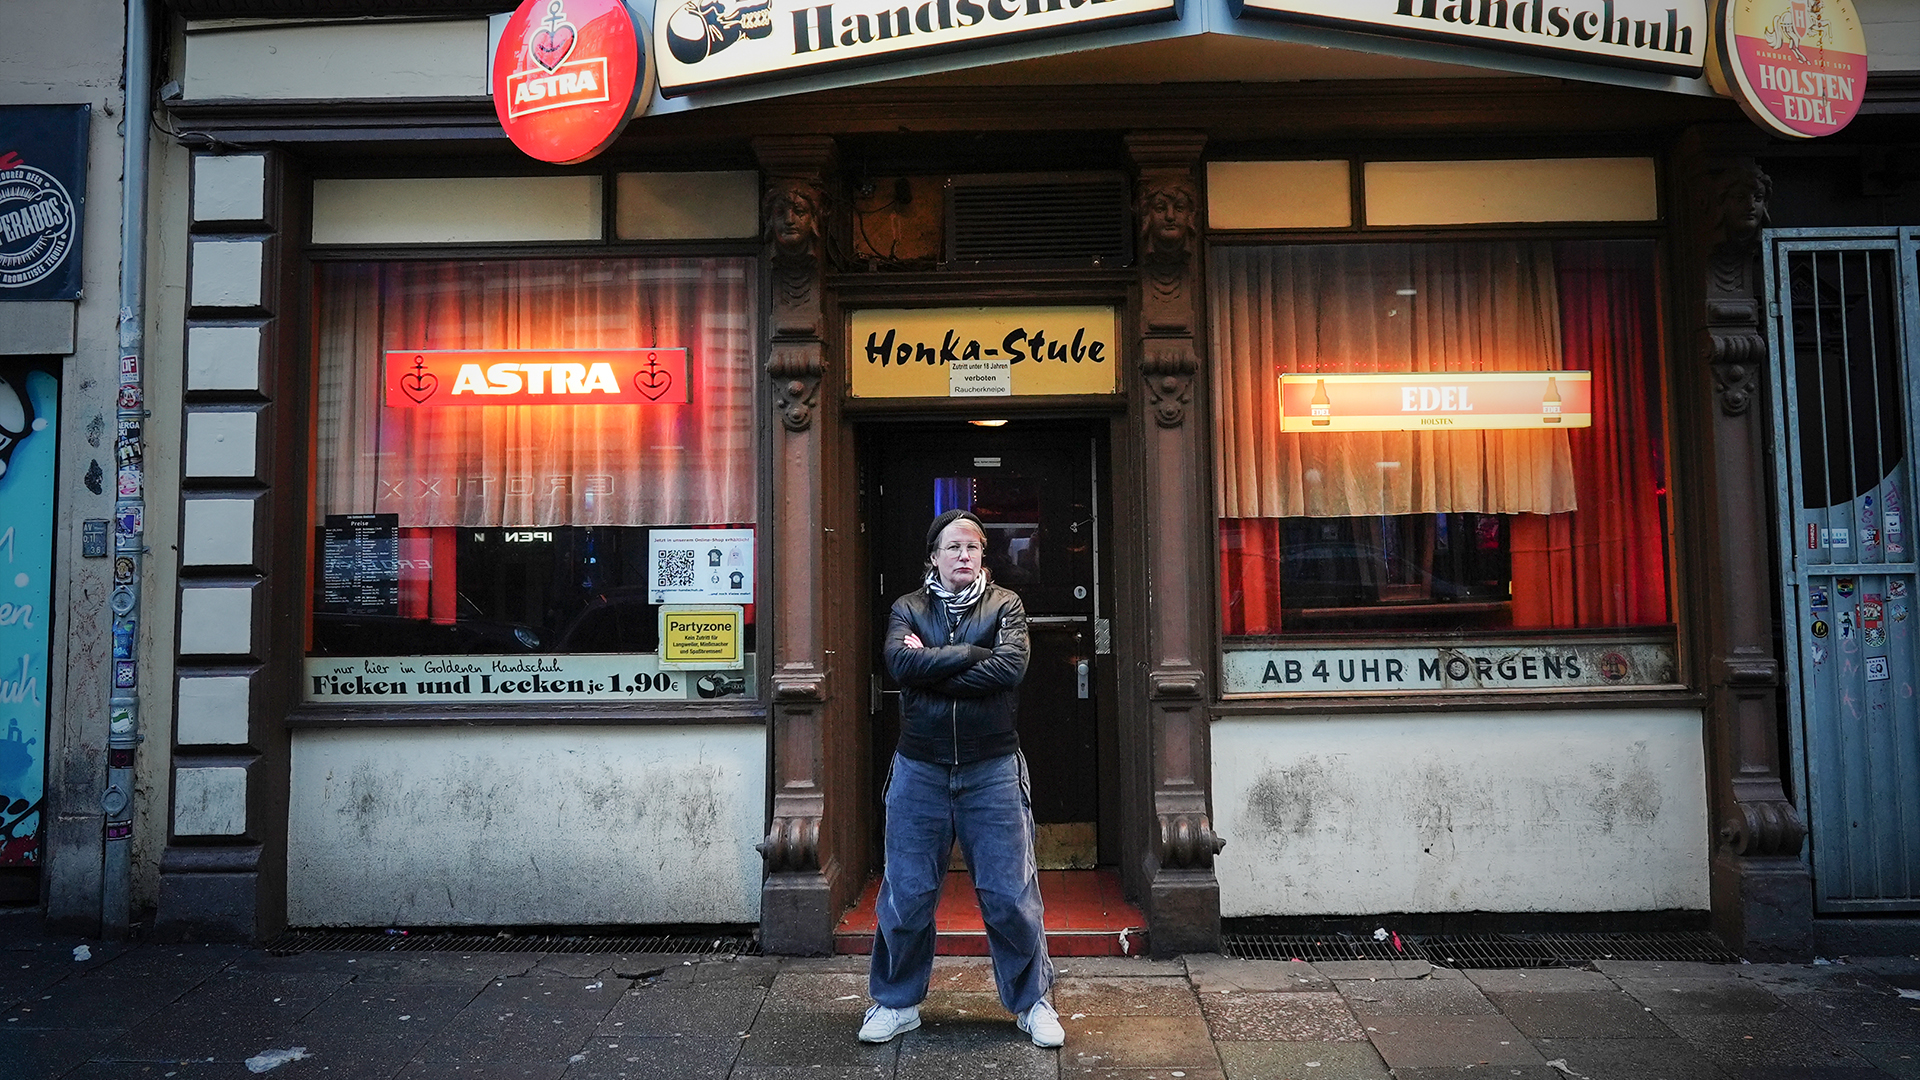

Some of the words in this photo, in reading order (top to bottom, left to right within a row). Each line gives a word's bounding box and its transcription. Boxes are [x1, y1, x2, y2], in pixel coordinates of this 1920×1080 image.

[790, 0, 1112, 55] Handsc
[514, 70, 598, 105] ASTRA
[1759, 64, 1853, 101] HOLSTEN
[1782, 94, 1837, 125] EDEL
[26, 171, 43, 187] BEER
[44, 241, 66, 268] TEQUILA
[865, 327, 1105, 367] Honka-Stube
[451, 362, 621, 395] ASTRA
[954, 386, 1005, 394] Raucherkneipe
[1311, 408, 1330, 416] EDEL
[1401, 386, 1473, 412] EDEL
[1543, 405, 1562, 414] EDEL
[670, 621, 732, 632] Partyzone
[334, 665, 354, 674] nur
[364, 659, 389, 674] hier
[400, 662, 415, 674] im
[424, 660, 482, 674] Goldenen
[492, 658, 563, 673] Handschuh
[1261, 660, 1302, 684] AB
[1312, 660, 1330, 682] 4
[1338, 659, 1404, 683] UHR
[1418, 656, 1581, 681] MORGENS
[311, 674, 407, 695] Ficken
[416, 675, 471, 695] und
[480, 673, 585, 695] Lecken
[587, 680, 604, 695] je
